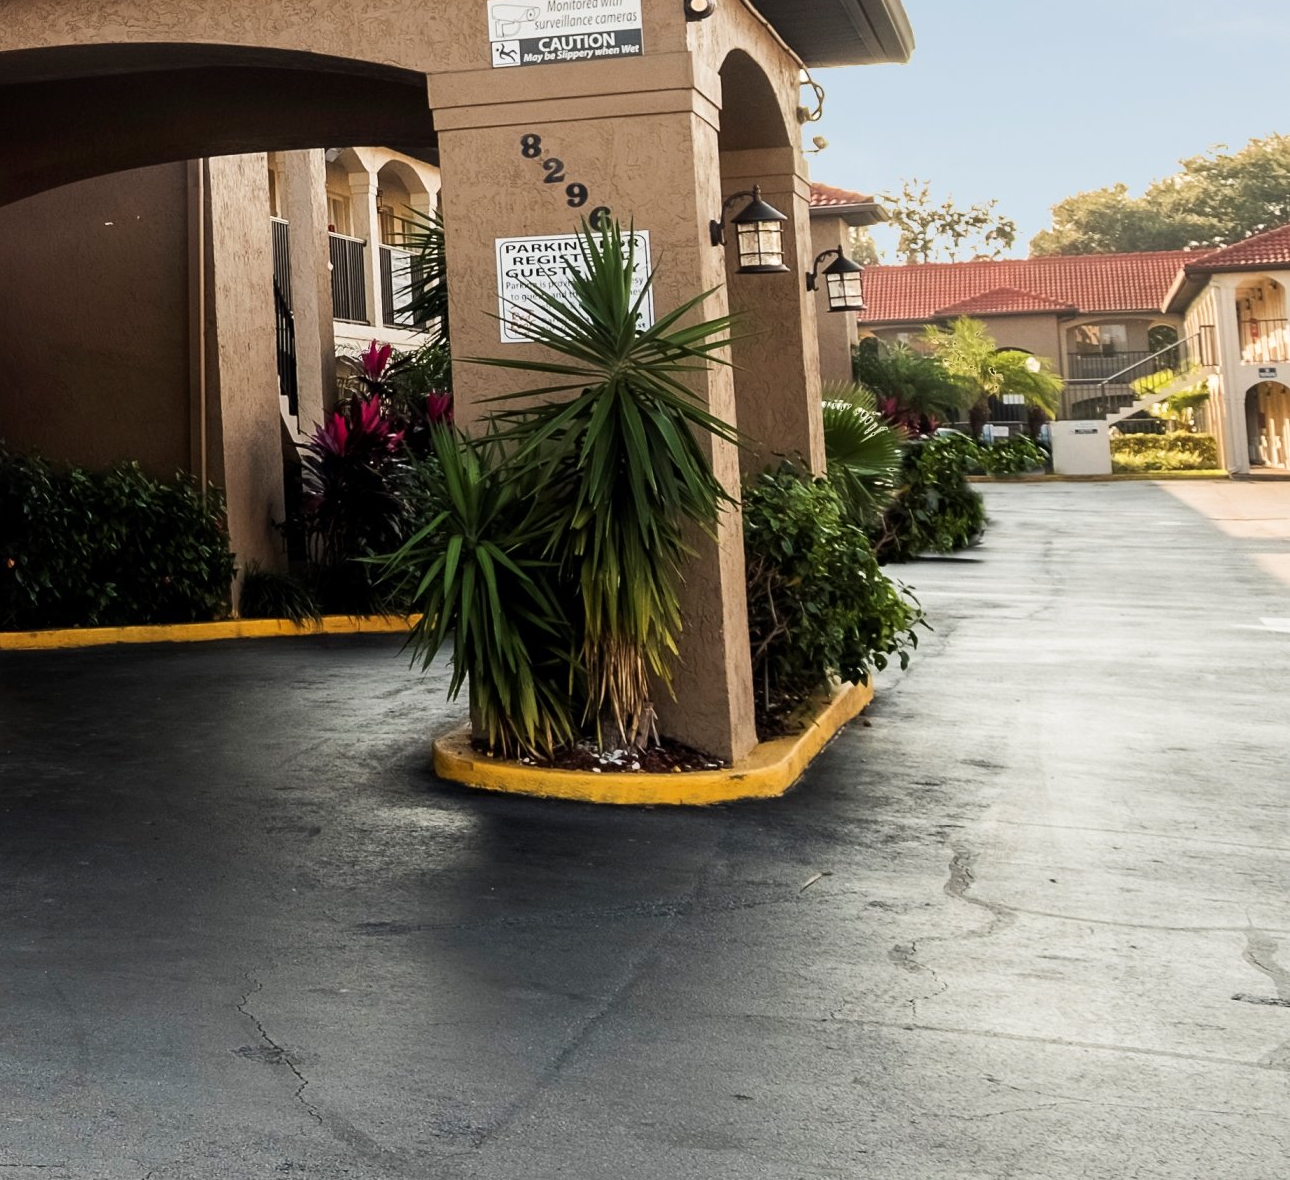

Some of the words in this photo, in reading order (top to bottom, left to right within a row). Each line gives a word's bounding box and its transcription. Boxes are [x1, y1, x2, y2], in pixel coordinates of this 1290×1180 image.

[534, 14, 593, 30] surveillance
[595, 11, 638, 25] cameras
[538, 32, 616, 52] CAUTION
[523, 53, 543, 63] May
[544, 51, 555, 60] be
[557, 48, 594, 61] Slippery
[595, 45, 620, 56] when
[621, 43, 640, 54] Wet
